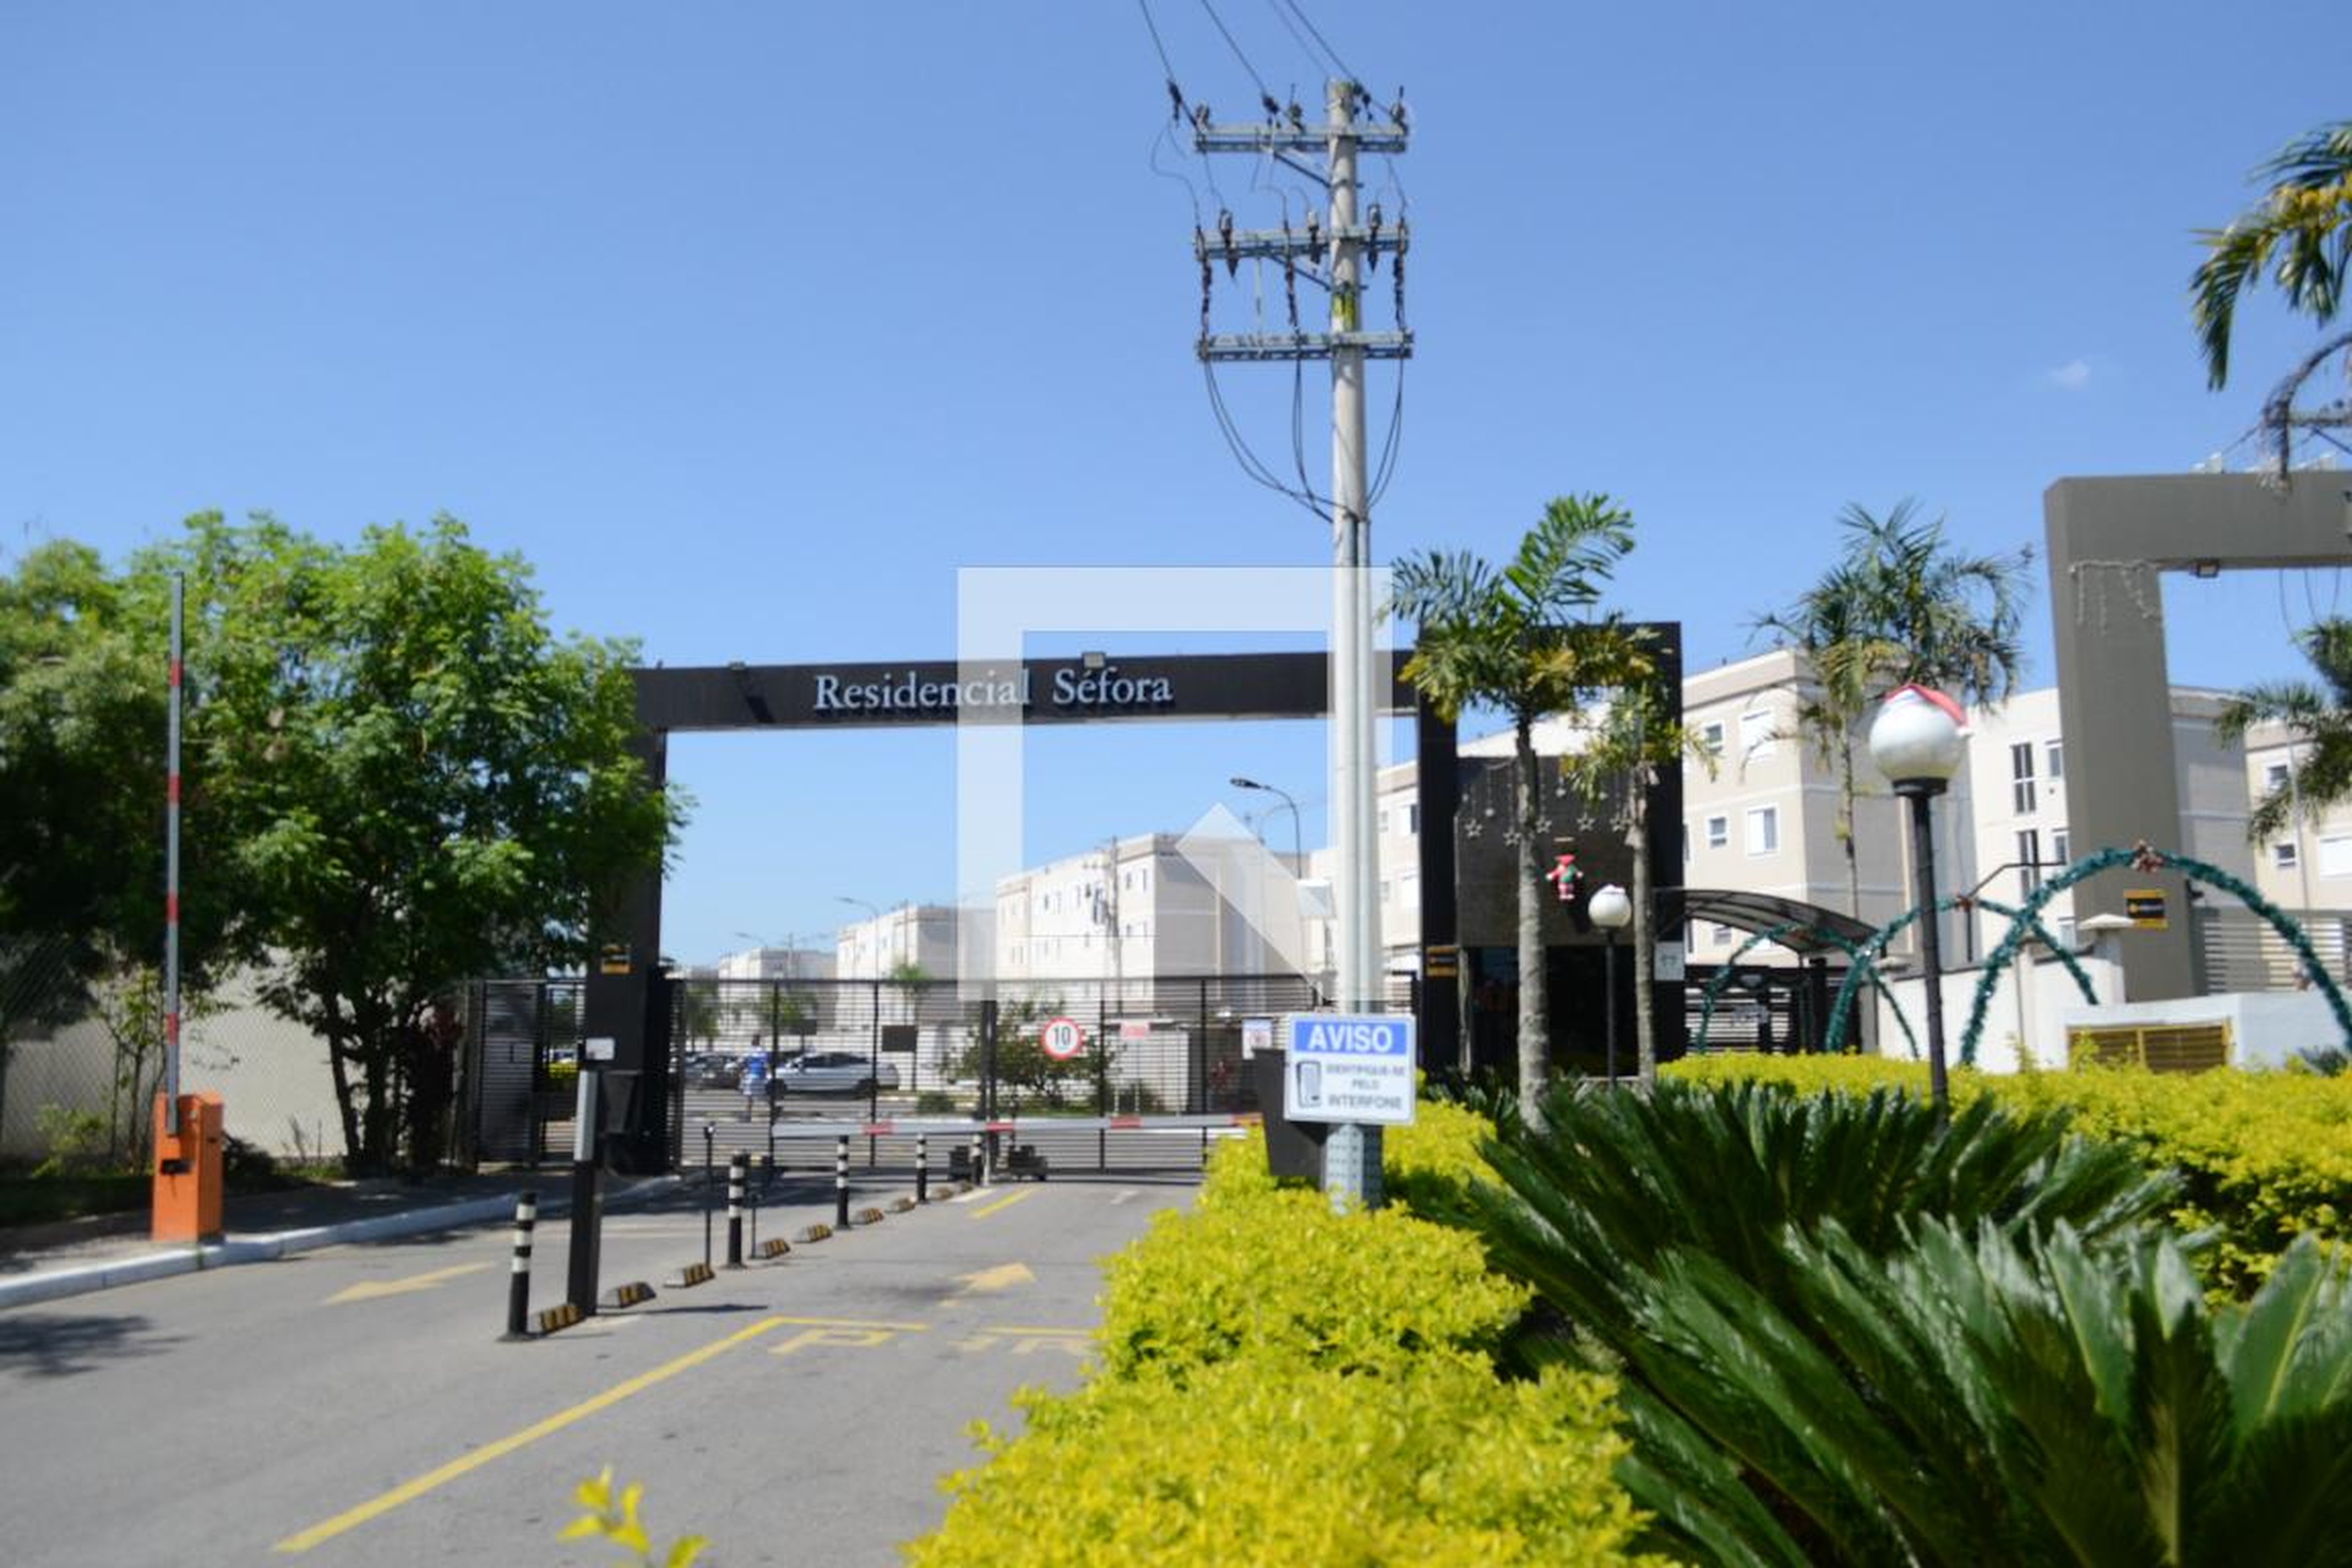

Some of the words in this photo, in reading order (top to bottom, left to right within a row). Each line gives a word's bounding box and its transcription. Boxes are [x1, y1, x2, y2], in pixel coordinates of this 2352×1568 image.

[813, 669, 1031, 710] Residencial
[1053, 666, 1174, 704] Séfora
[1054, 1025, 1071, 1049] 10
[1307, 1024, 1393, 1052] AVISO
[1329, 1095, 1402, 1110] INTERFONE
